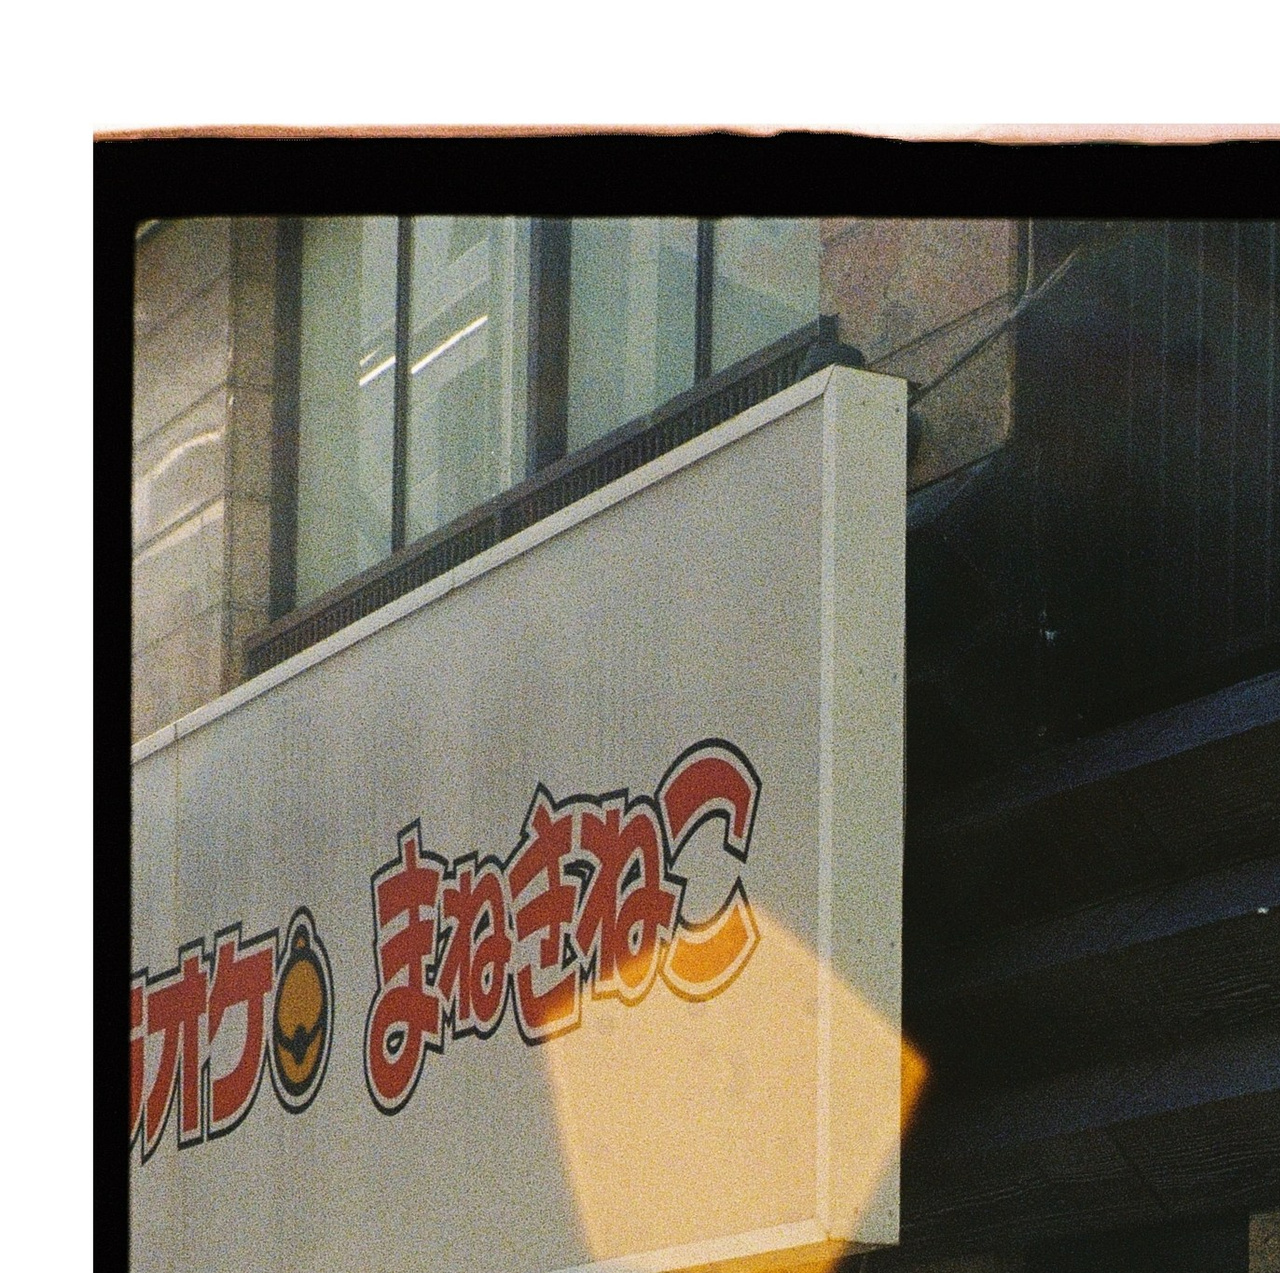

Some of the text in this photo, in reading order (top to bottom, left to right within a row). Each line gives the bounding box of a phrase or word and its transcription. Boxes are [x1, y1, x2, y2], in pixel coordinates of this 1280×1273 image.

[131, 738, 761, 1163] オケ まねきねこ
